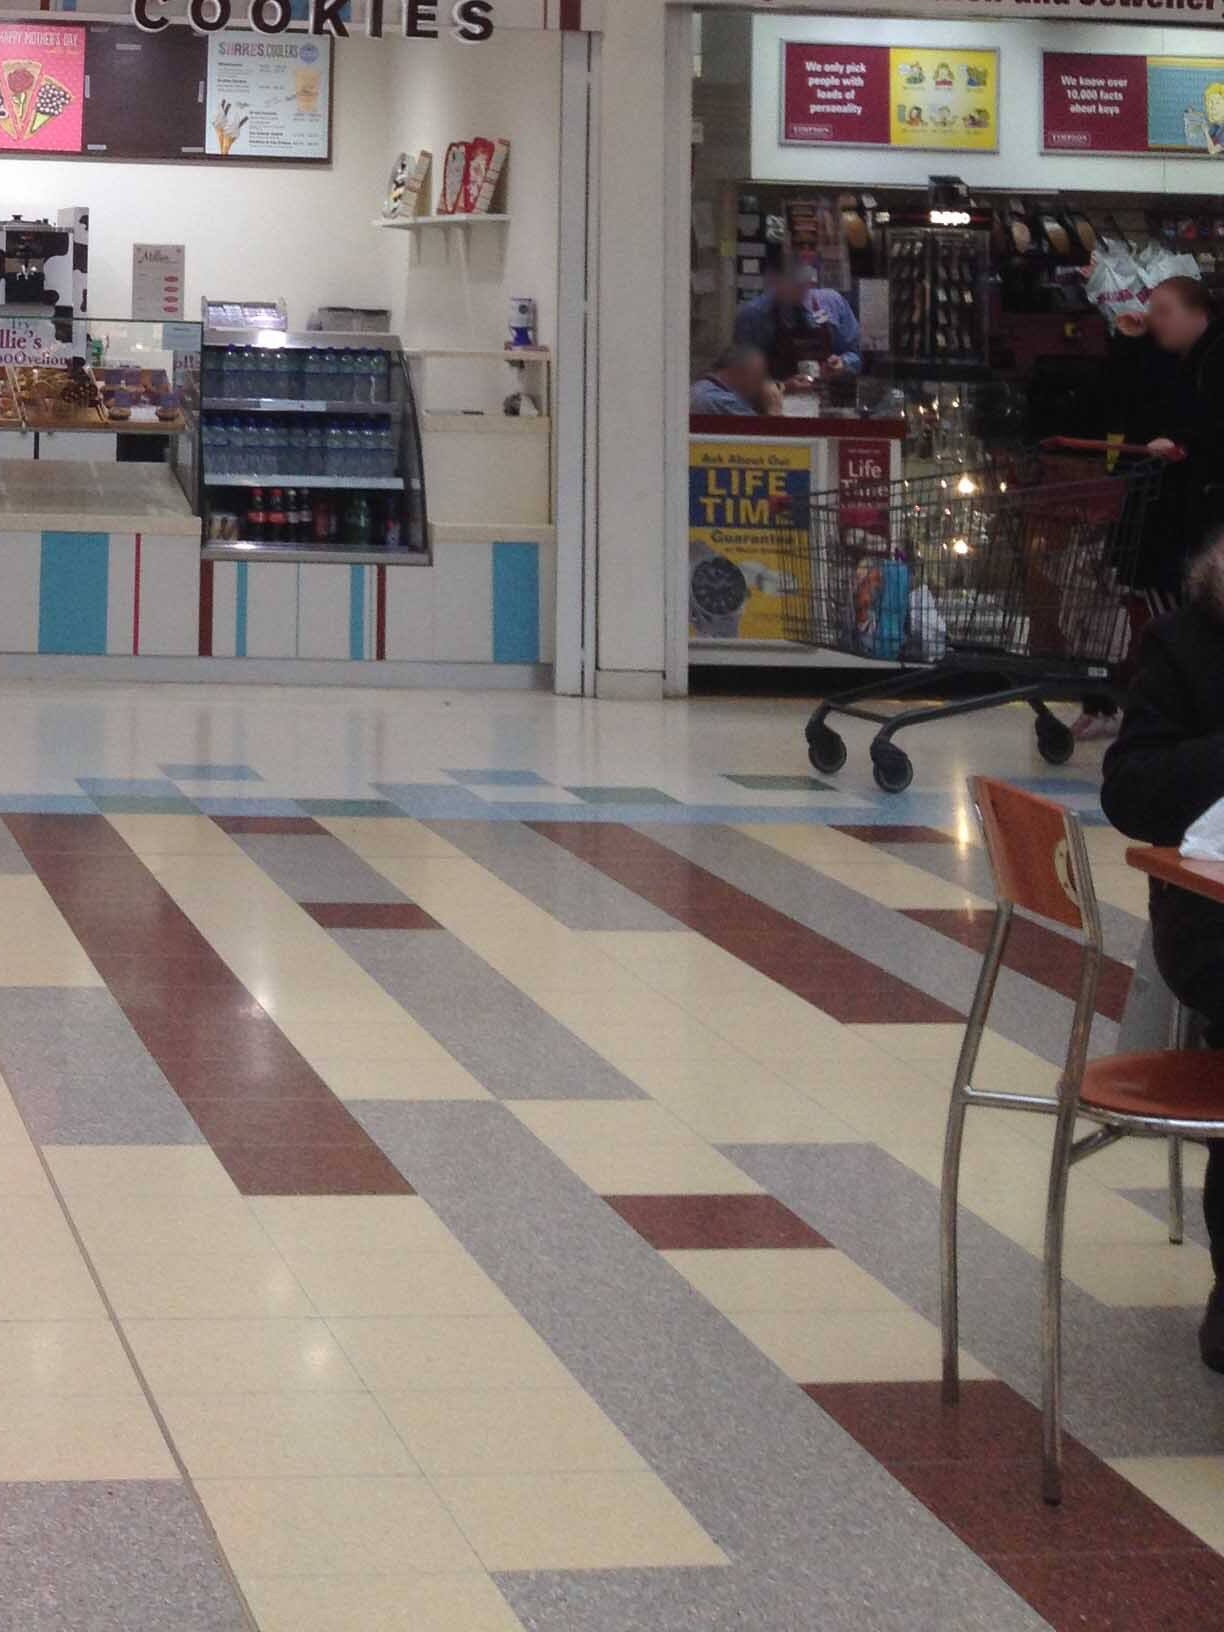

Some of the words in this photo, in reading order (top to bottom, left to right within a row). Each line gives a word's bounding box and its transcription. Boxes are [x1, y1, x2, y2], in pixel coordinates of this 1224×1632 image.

[63, 33, 79, 46] DAY
[805, 62, 823, 73] We
[825, 63, 844, 75] only
[846, 63, 866, 74] pick
[808, 77, 840, 88] people
[842, 76, 864, 87] with
[1061, 76, 1077, 86] We
[1080, 76, 1105, 86] know
[1107, 78, 1128, 87] over
[817, 89, 842, 99] loads
[845, 89, 855, 99] of
[1100, 91, 1123, 101] facts
[810, 103, 862, 115] personality
[1070, 104, 1097, 114] about
[1098, 104, 1120, 116] keys
[728, 454, 764, 465] About
[848, 459, 882, 478] Life
[706, 469, 788, 496] LIFE
